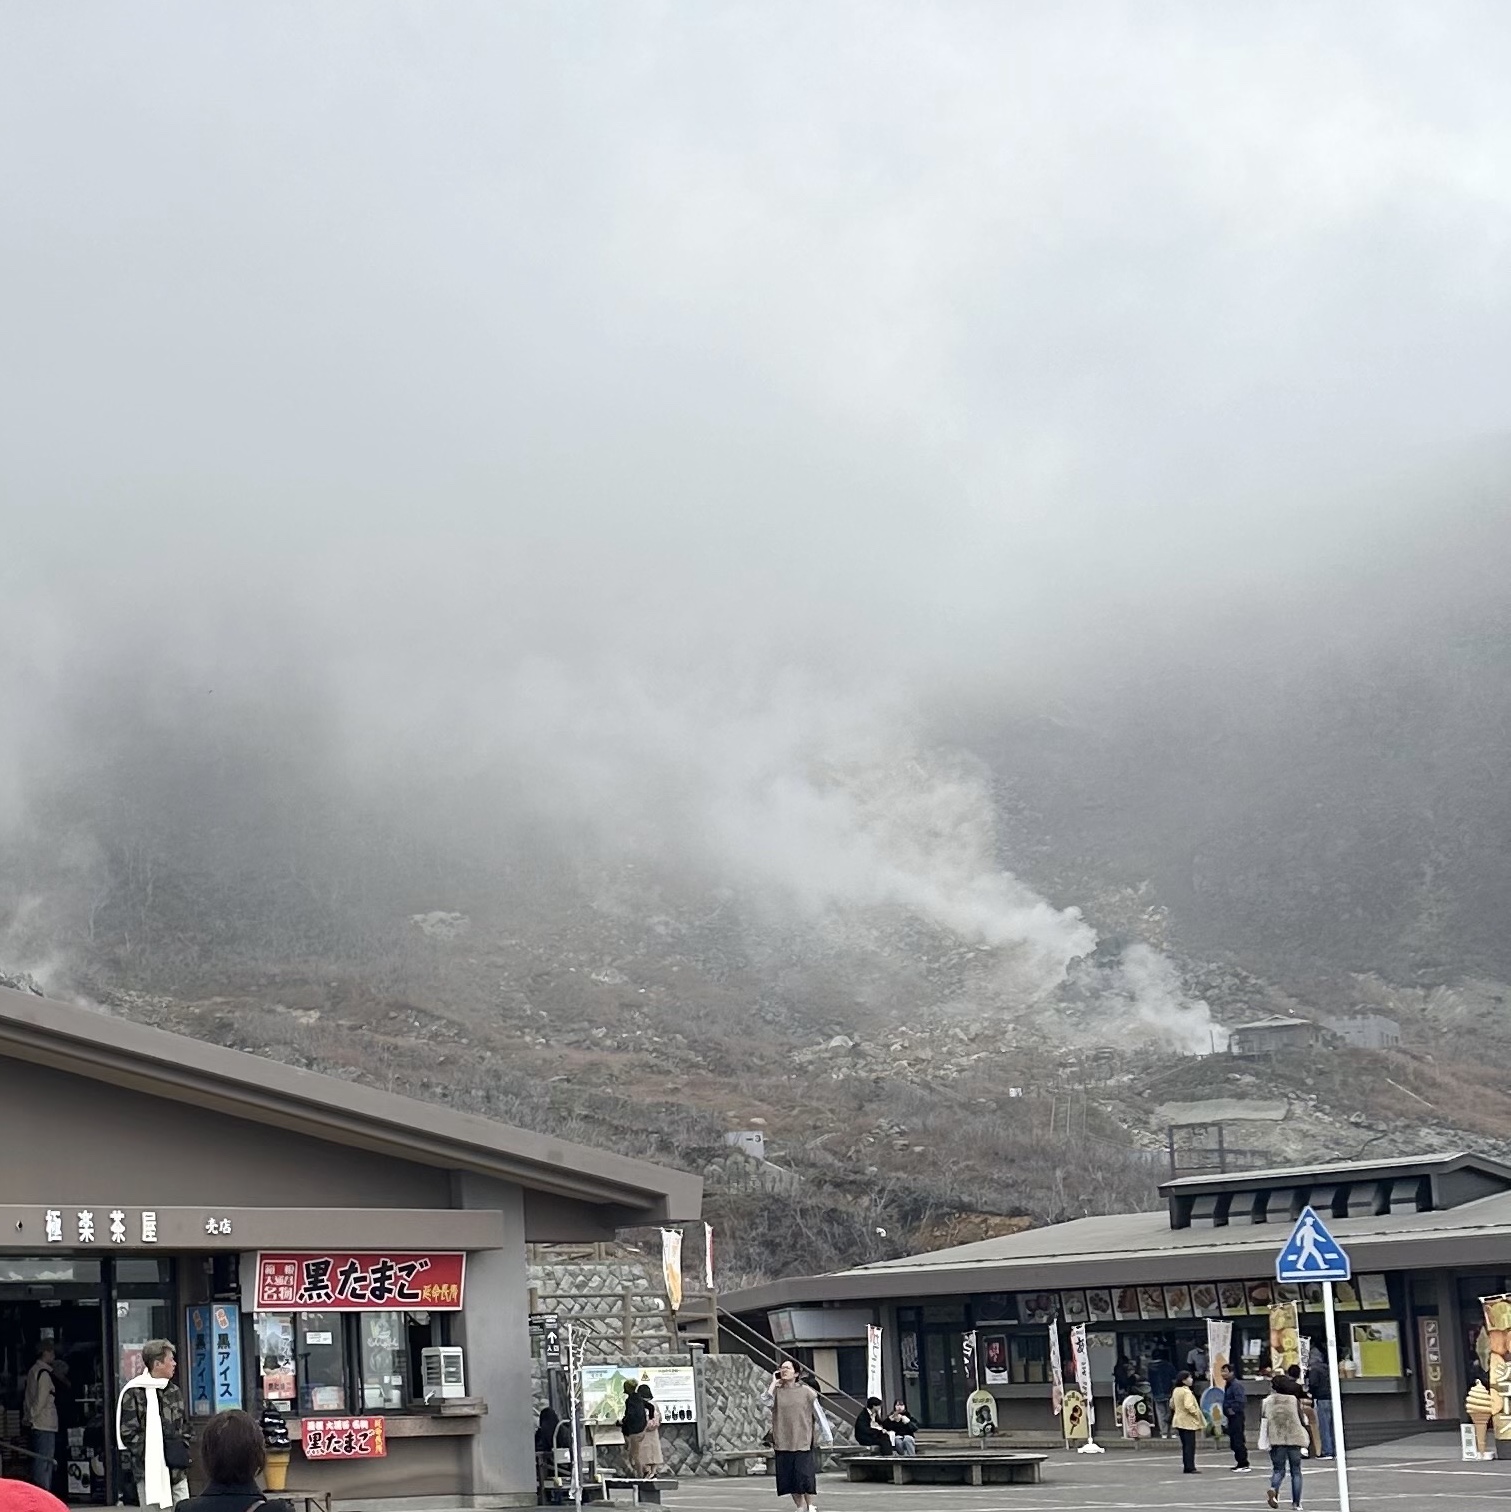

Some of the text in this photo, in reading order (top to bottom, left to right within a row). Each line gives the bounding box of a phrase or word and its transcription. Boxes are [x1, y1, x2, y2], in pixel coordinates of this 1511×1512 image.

[45, 1210, 157, 1243] 極楽茶屋
[205, 1217, 232, 1235] 売店
[296, 1257, 432, 1304] 黒たまご
[217, 1333, 233, 1398] 黒アイス
[306, 1430, 375, 1457] 黒たまご
